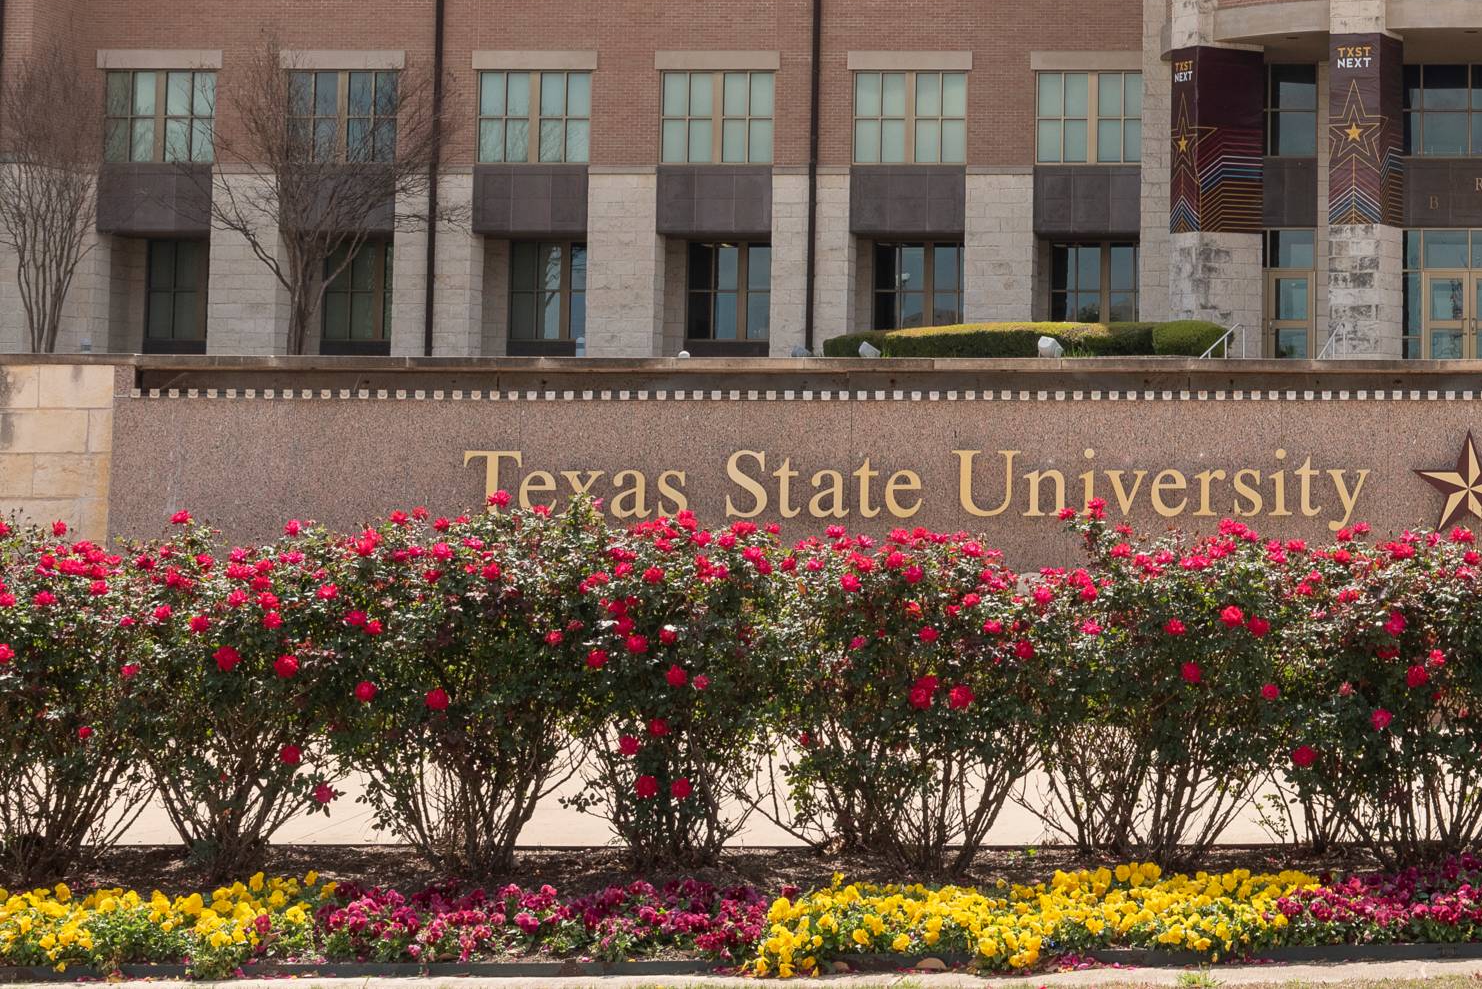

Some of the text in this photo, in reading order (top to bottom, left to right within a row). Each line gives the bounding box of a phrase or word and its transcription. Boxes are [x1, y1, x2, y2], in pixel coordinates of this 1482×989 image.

[1337, 46, 1372, 58] TXST
[1175, 60, 1194, 72] TXST
[1337, 57, 1372, 69] NEXT
[1174, 71, 1193, 83] NEXT
[463, 448, 1371, 531] Texas State University
